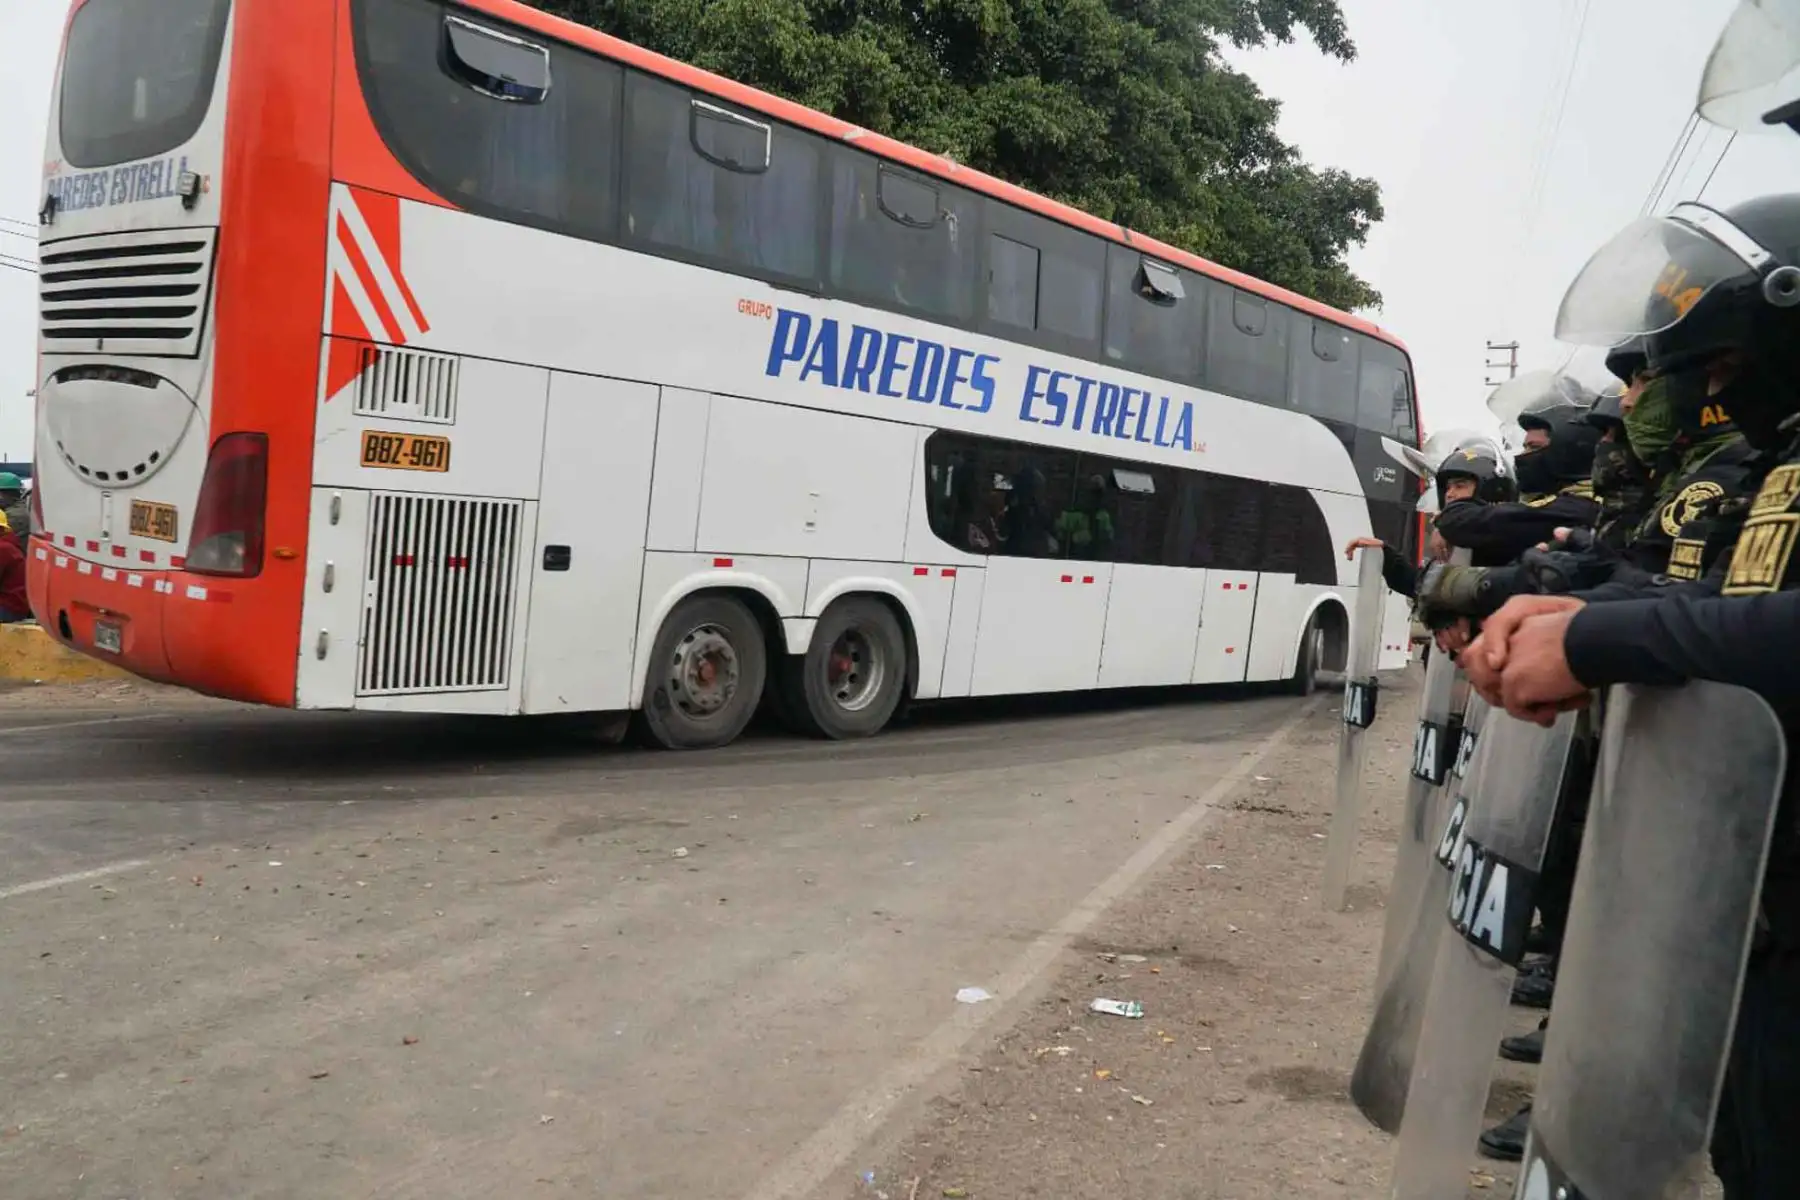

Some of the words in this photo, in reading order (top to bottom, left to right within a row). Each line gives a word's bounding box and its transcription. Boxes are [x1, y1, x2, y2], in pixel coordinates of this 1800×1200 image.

[738, 299, 772, 319] GRUPO
[765, 308, 1000, 413] PAREDES
[1019, 364, 1192, 452] ESTRELLA
